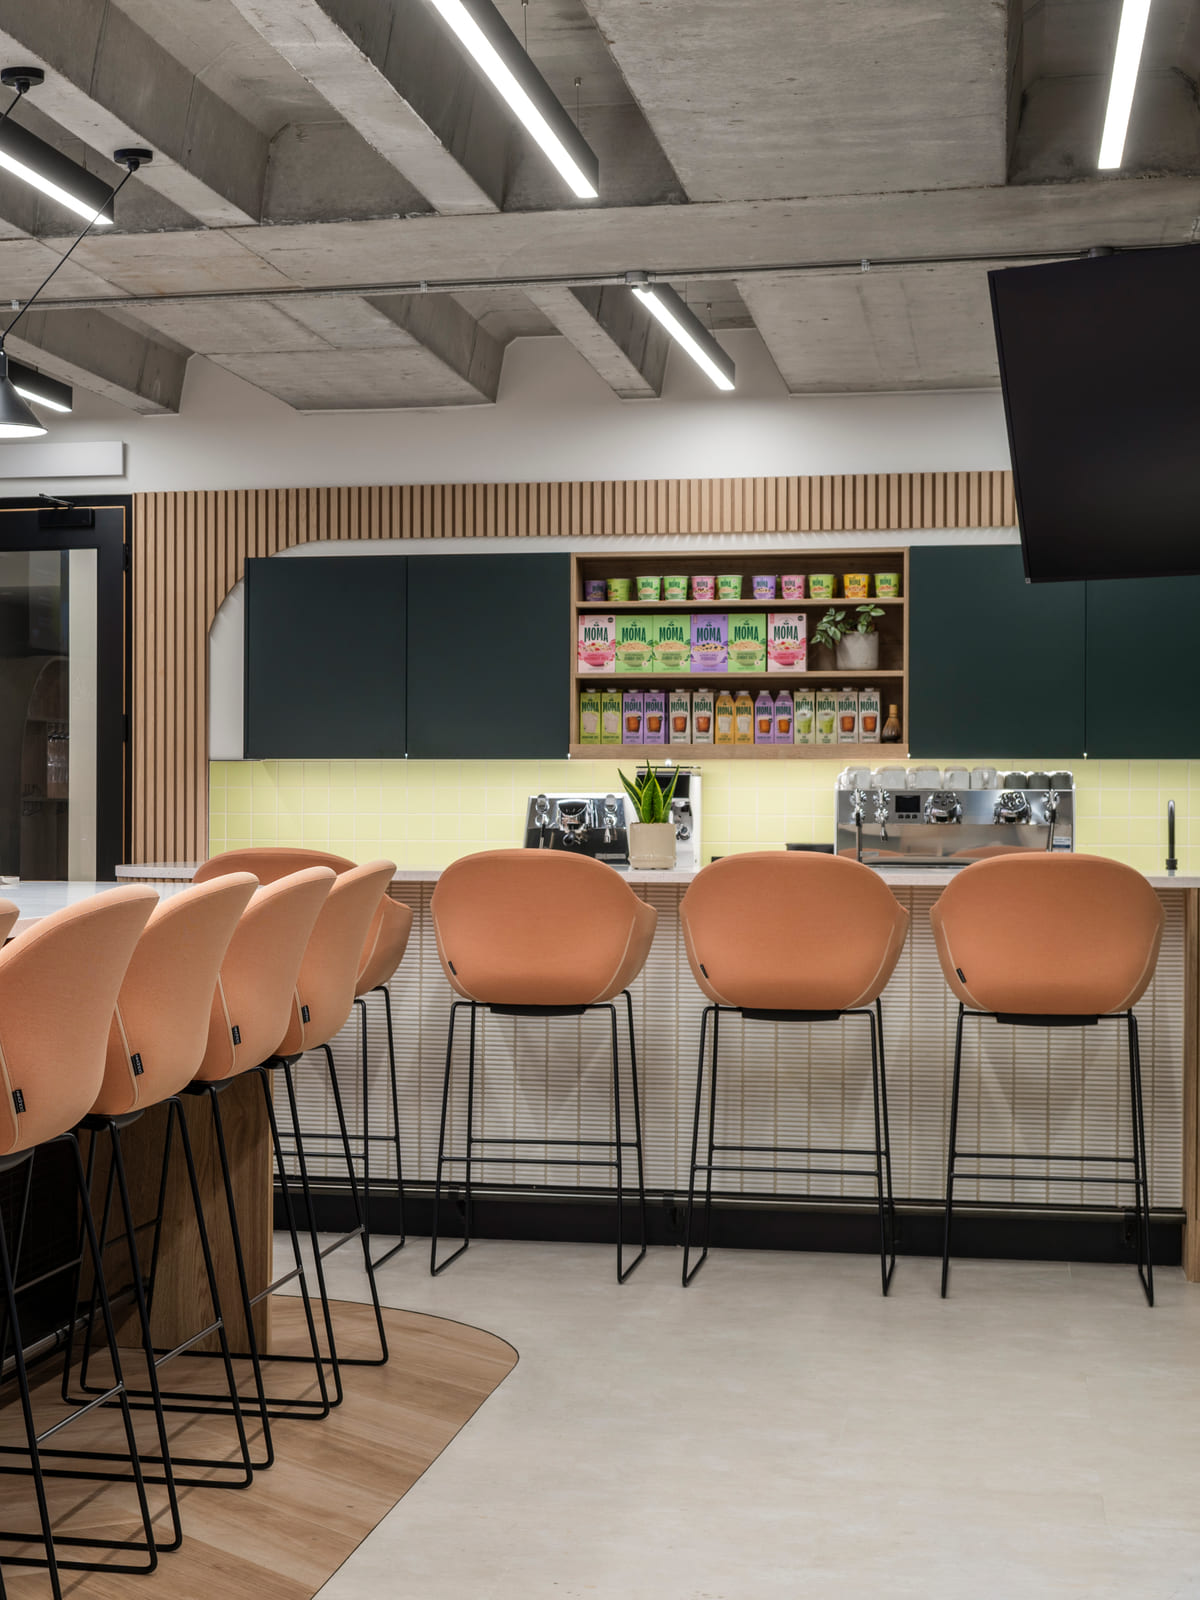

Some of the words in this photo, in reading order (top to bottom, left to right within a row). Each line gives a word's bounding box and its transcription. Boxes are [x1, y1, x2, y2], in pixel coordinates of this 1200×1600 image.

[584, 627, 608, 642] MOMA
[622, 627, 646, 643] MOMA
[659, 627, 684, 642] MOMA
[697, 627, 721, 643] MOMA
[734, 626, 759, 641] MOMA
[774, 626, 798, 641] MOMA
[582, 701, 599, 712] MOMA
[603, 701, 620, 712] MOMA
[624, 701, 641, 712] MOMA
[645, 701, 663, 712] MOMA
[670, 701, 688, 712] MOMA
[694, 701, 712, 712] MOMA
[717, 706, 732, 716] MOMA
[736, 706, 752, 716] MOMA
[756, 706, 772, 716] MOMA
[775, 706, 792, 716] MOMA
[795, 701, 813, 712] MOMA
[817, 701, 835, 712] MOMA
[838, 701, 856, 712] MOMA
[860, 701, 878, 712] MOMA
